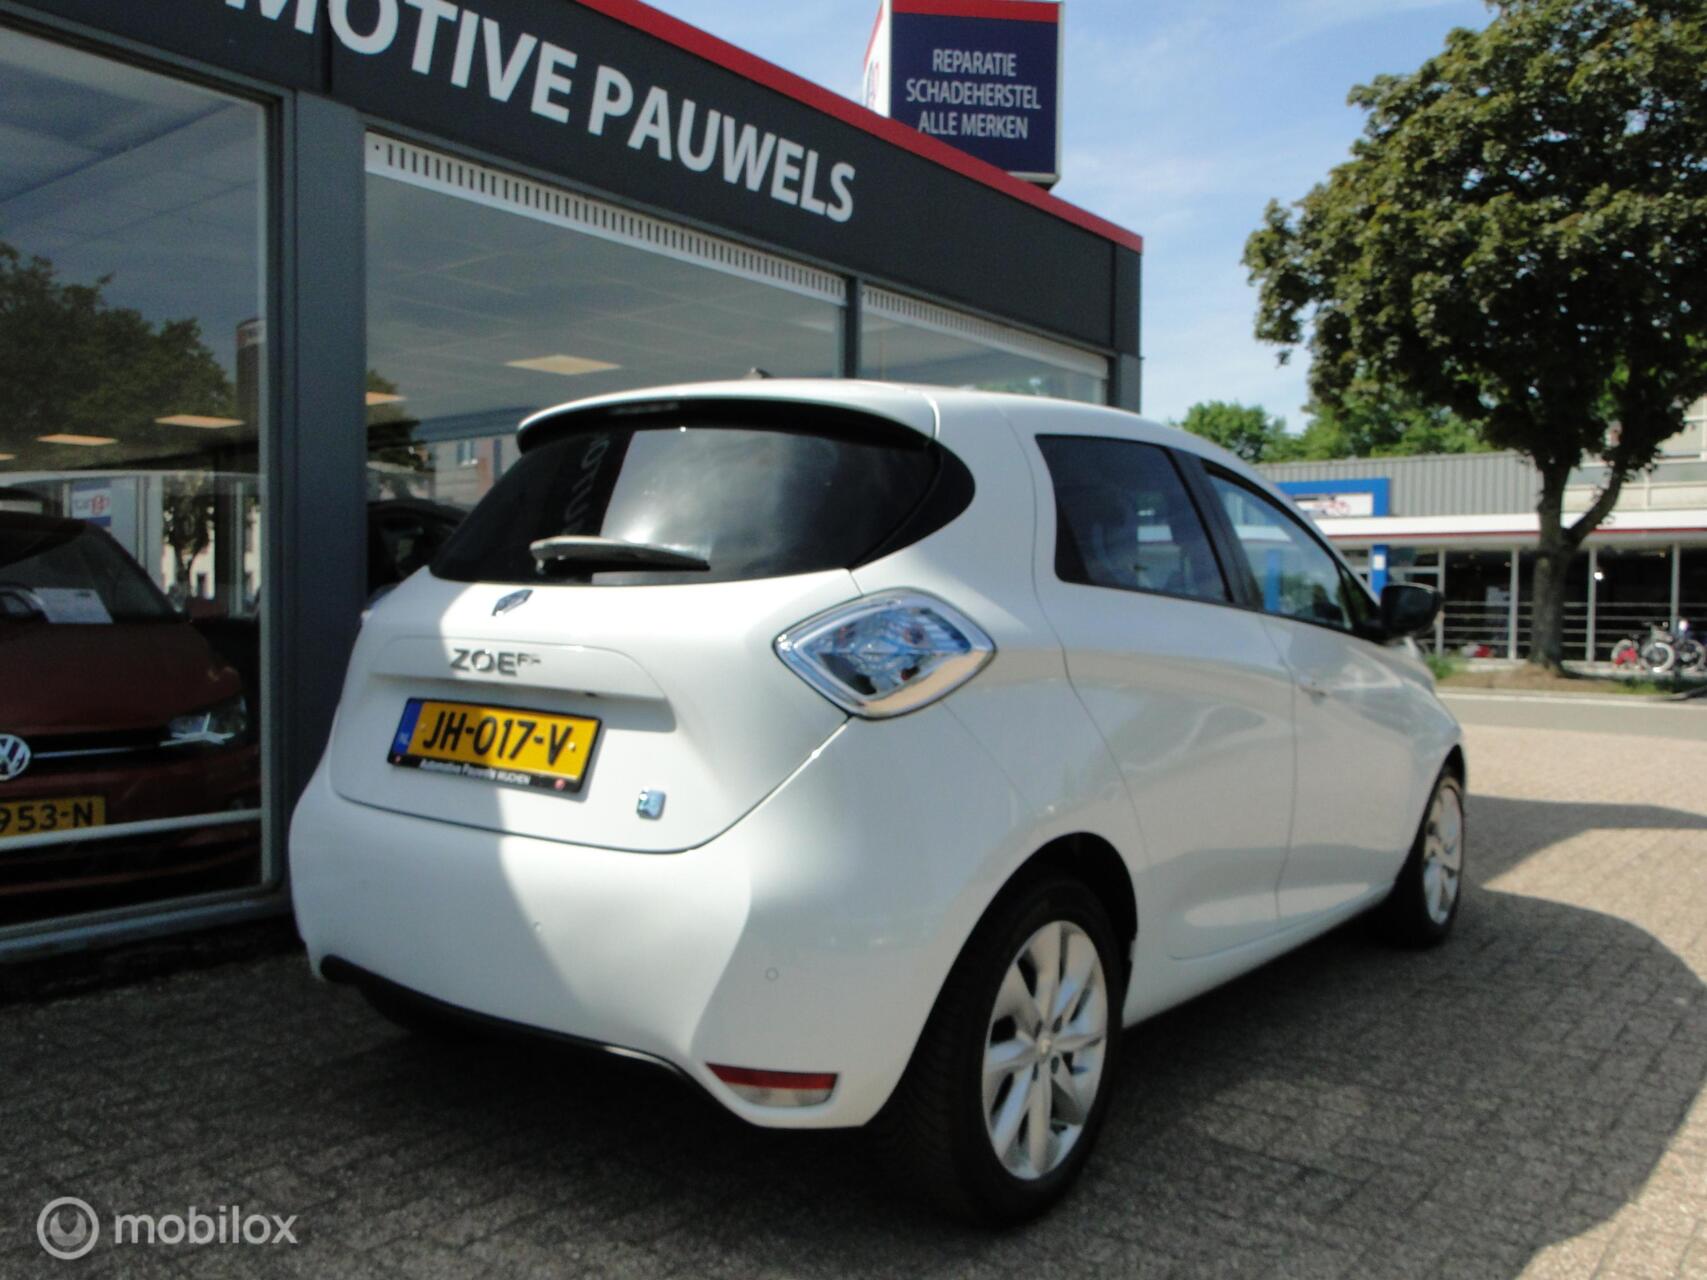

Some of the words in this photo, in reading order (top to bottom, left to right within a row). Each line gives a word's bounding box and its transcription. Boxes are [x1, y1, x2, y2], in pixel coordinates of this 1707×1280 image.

[932, 48, 1018, 77] REPARATIE
[905, 78, 1042, 110] SCHADEHERSTEL
[225, 0, 578, 124] OTIVE
[587, 64, 856, 223] PAUWELS
[917, 110, 958, 136] ALLE
[961, 113, 1029, 139] MERKEN
[450, 648, 518, 677] ZOE
[423, 710, 573, 766] JH-017-V
